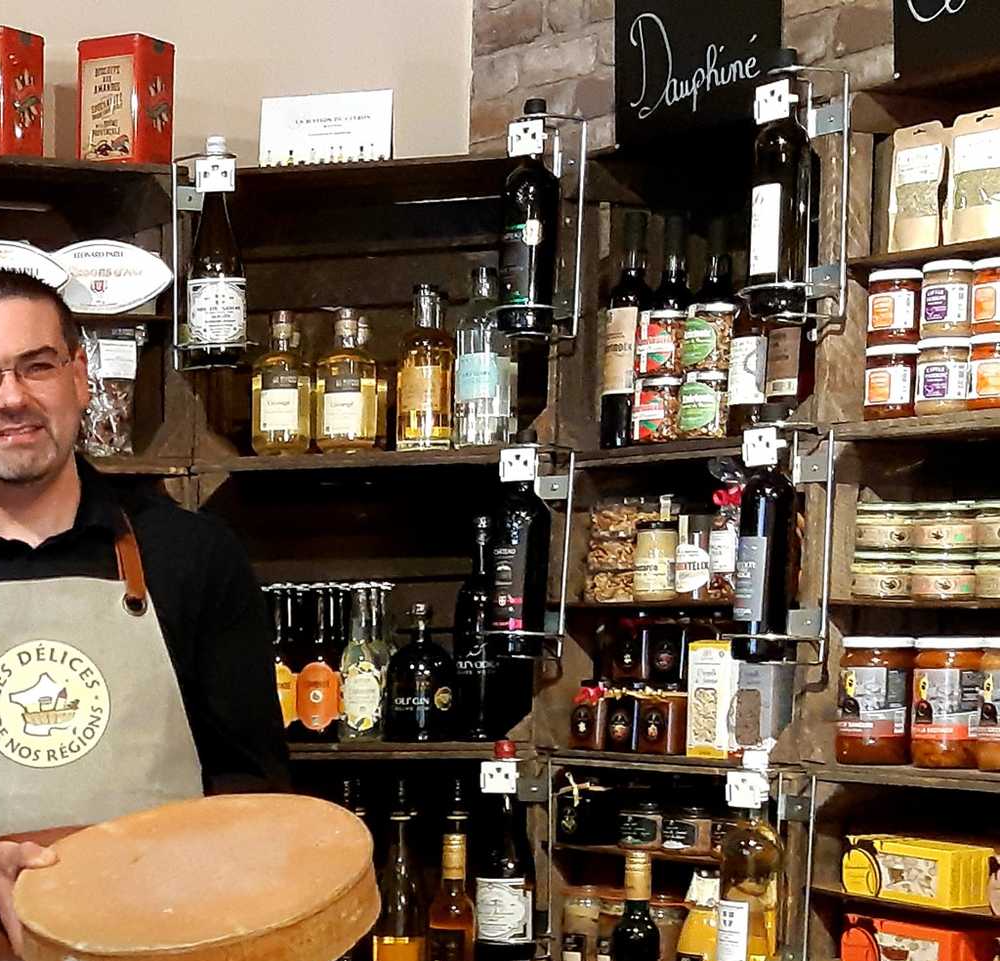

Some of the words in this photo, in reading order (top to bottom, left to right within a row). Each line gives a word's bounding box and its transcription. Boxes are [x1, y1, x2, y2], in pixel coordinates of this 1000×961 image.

[630, 13, 761, 118] Dauphiné
[16, 643, 100, 689] DÉLICES
[4, 738, 41, 761] NOS
[46, 704, 104, 762] RÉGIONS
